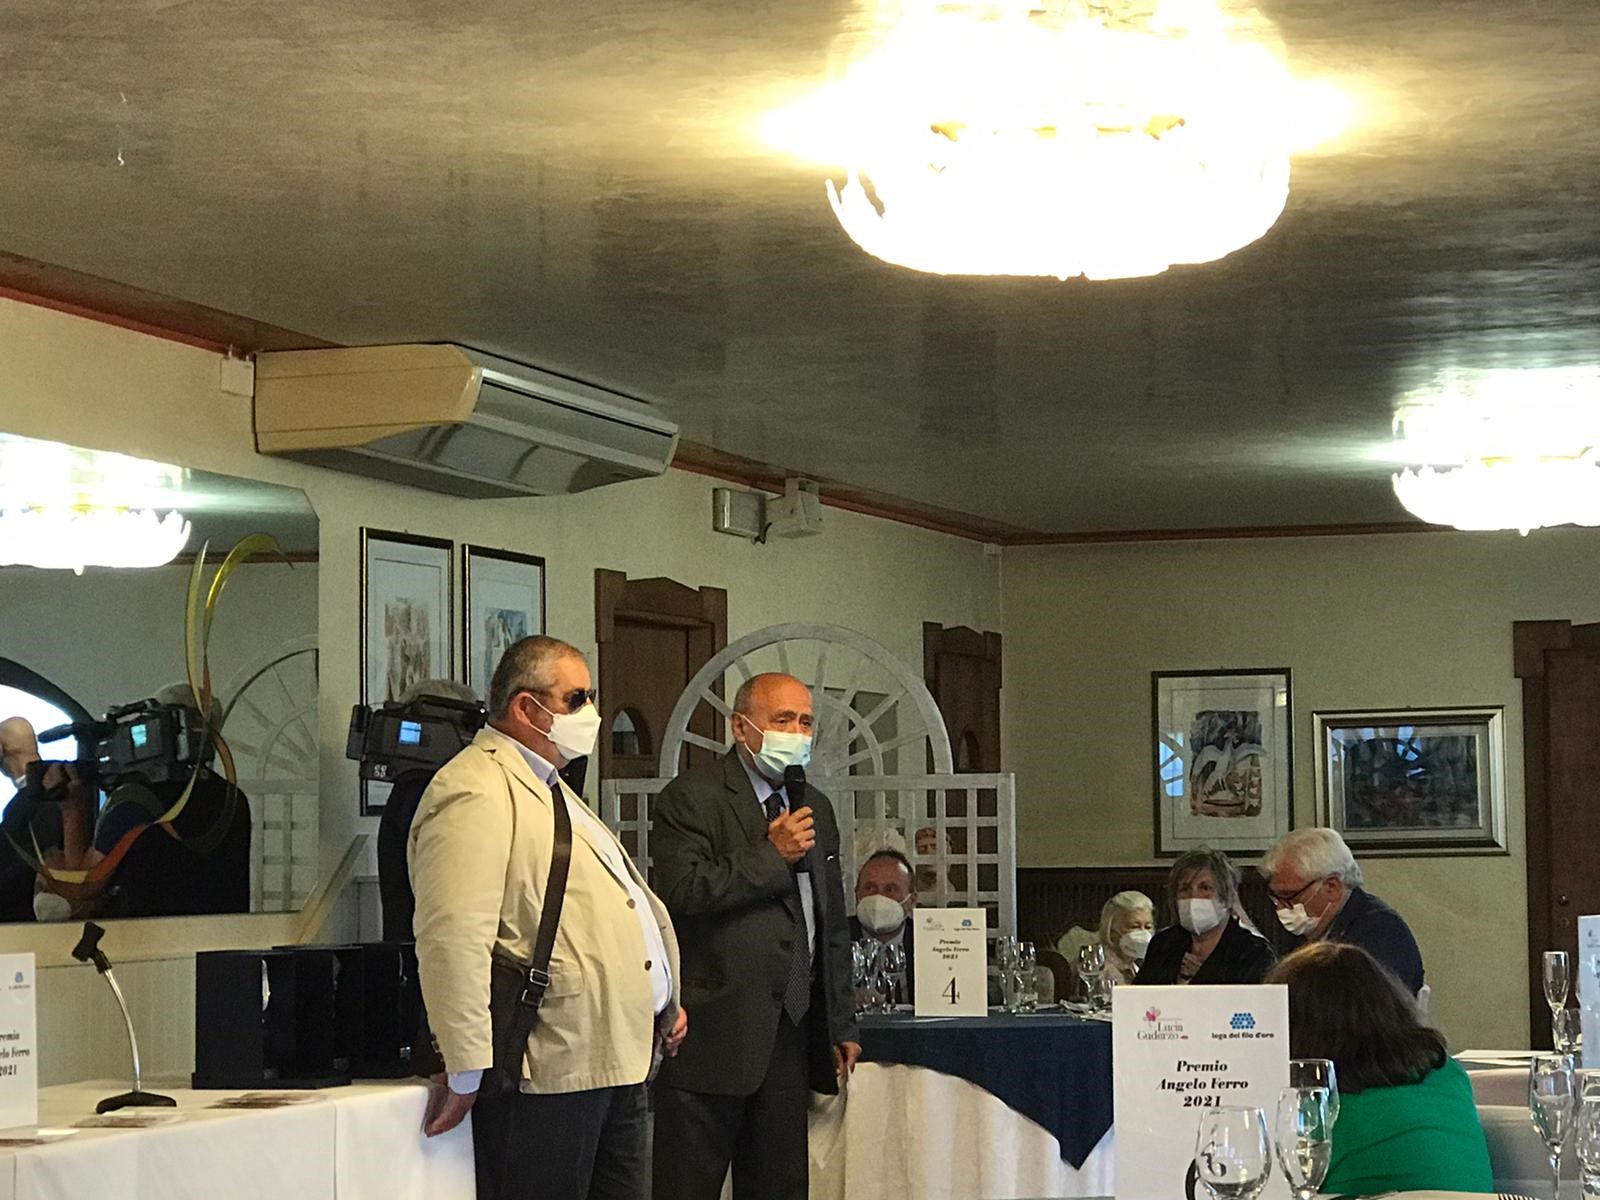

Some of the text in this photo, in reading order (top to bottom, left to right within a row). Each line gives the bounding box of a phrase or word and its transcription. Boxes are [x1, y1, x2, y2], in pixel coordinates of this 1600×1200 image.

[941, 976, 960, 1005] 4
[1157, 1022, 1183, 1033] Lucia
[0, 1030, 20, 1041] remio
[1137, 1030, 1179, 1041] Guderzo
[1176, 1059, 1228, 1073] Premio
[1156, 1077, 1249, 1093] Angelo Ferro
[1183, 1095, 1222, 1108] 2021
